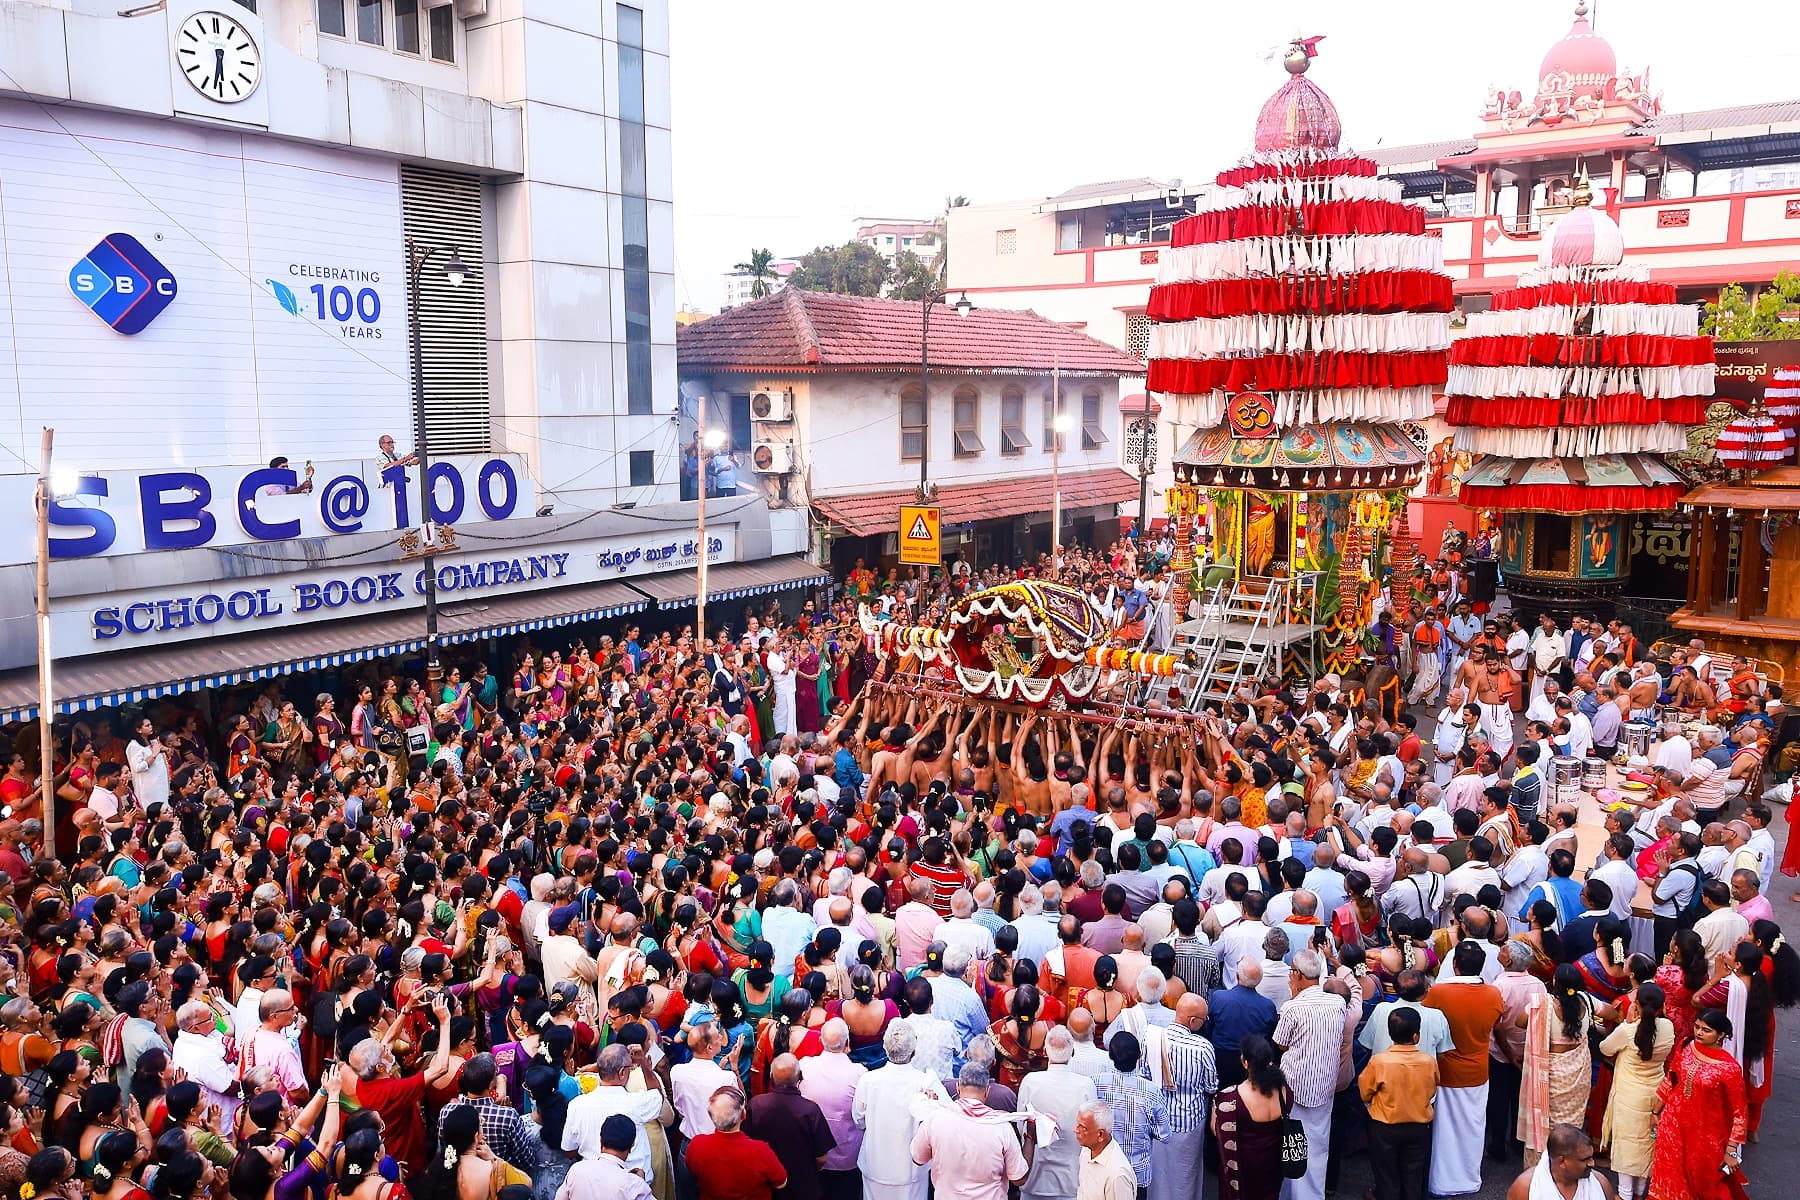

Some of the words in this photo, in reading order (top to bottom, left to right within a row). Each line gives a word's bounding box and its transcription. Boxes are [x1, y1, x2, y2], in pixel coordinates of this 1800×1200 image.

[289, 264, 380, 283] CELEBRATING
[76, 274, 173, 296] SBC
[310, 284, 381, 323] 100
[340, 326, 382, 339] YEARS
[93, 588, 283, 640] SCHOOL
[292, 572, 404, 613] BOOK
[414, 552, 570, 595] COMPANY
